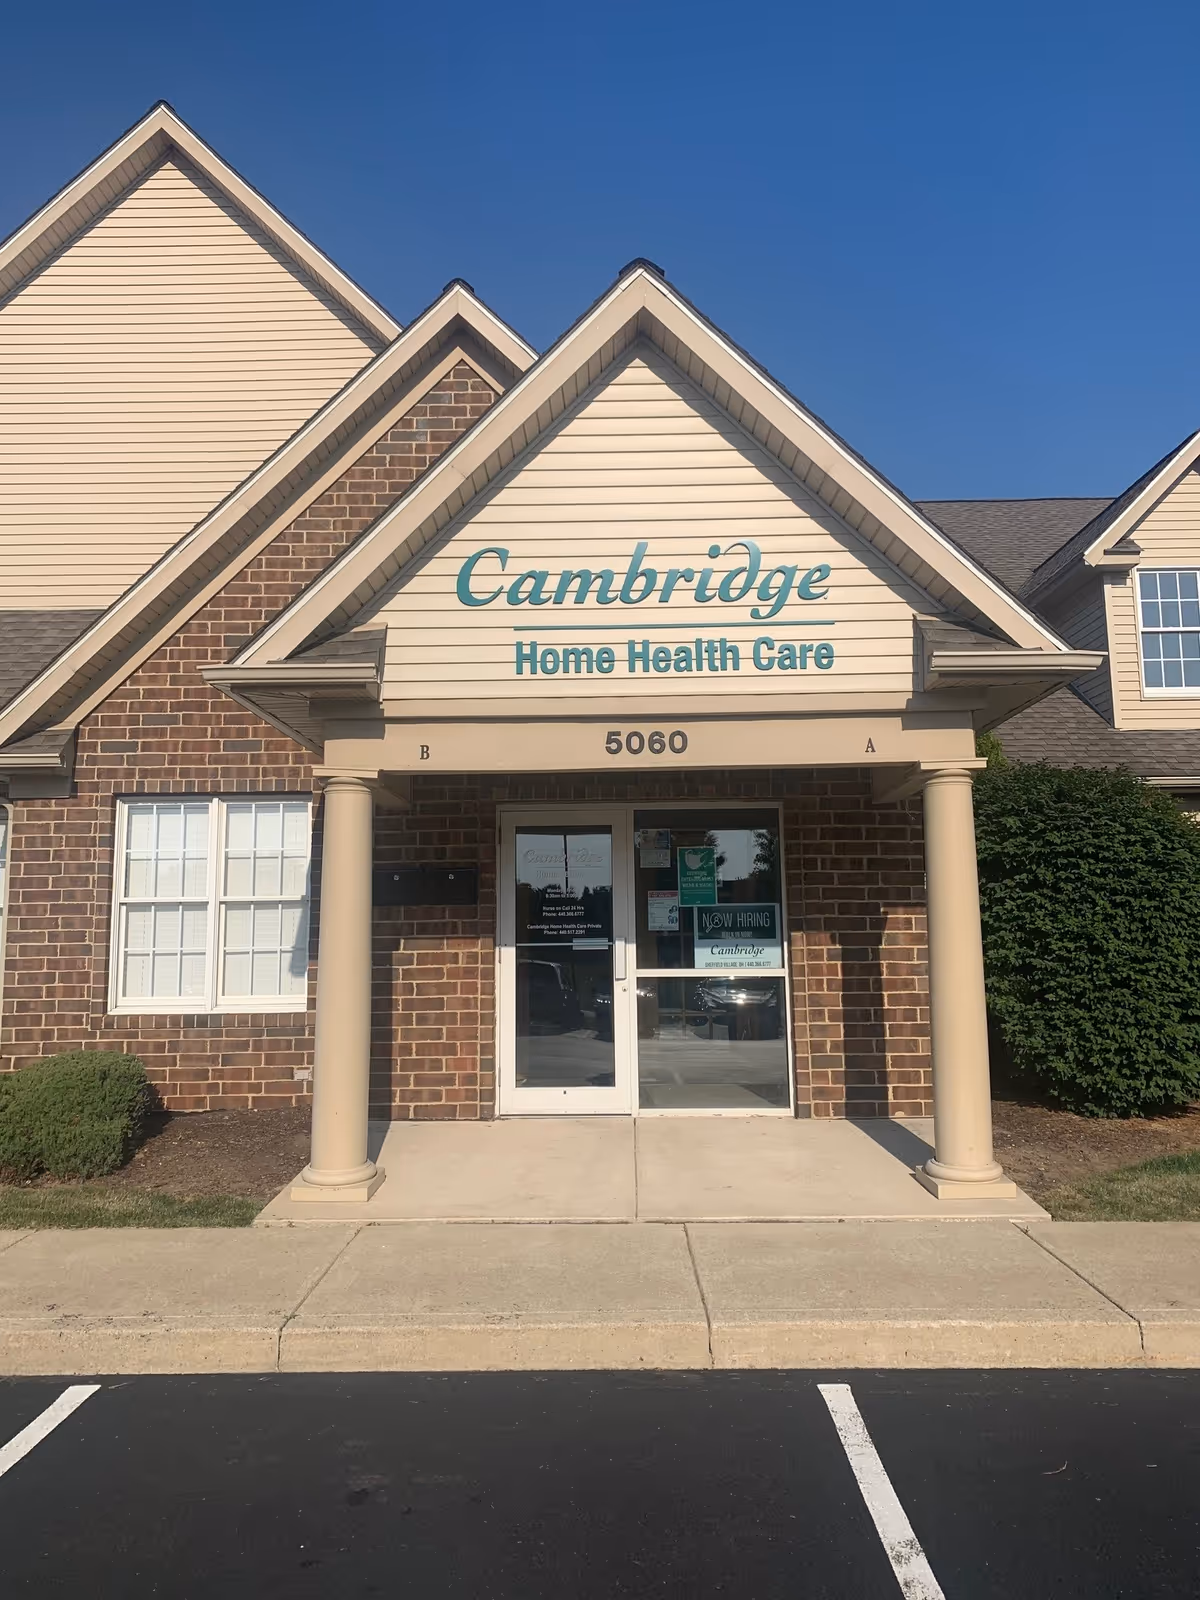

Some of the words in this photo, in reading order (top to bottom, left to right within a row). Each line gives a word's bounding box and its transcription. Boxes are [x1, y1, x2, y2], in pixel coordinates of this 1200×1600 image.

[456, 540, 832, 620] Cambridge
[515, 641, 616, 675] Home
[627, 638, 740, 672] Health
[752, 636, 835, 671] Care
[604, 730, 689, 755] 5060
[864, 738, 877, 754] A
[419, 744, 431, 760] B
[736, 912, 770, 928] HIRING
[711, 944, 764, 957] Cambridge
